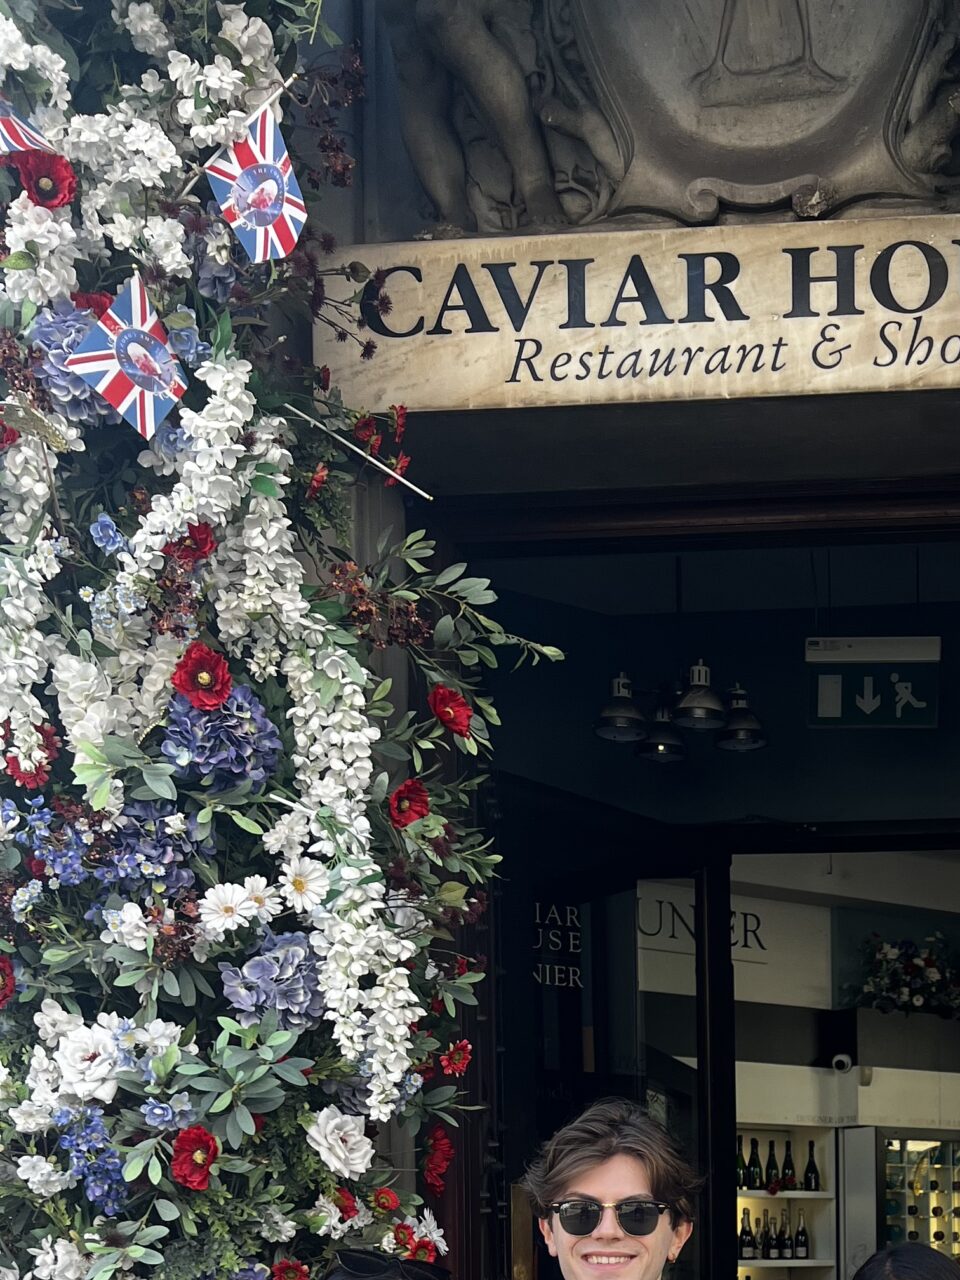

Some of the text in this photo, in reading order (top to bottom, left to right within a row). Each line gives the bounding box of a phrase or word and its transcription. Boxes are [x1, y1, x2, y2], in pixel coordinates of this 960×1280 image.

[361, 251, 751, 338] CAVIAR
[505, 336, 789, 383] Restaurant
[811, 323, 852, 369] &
